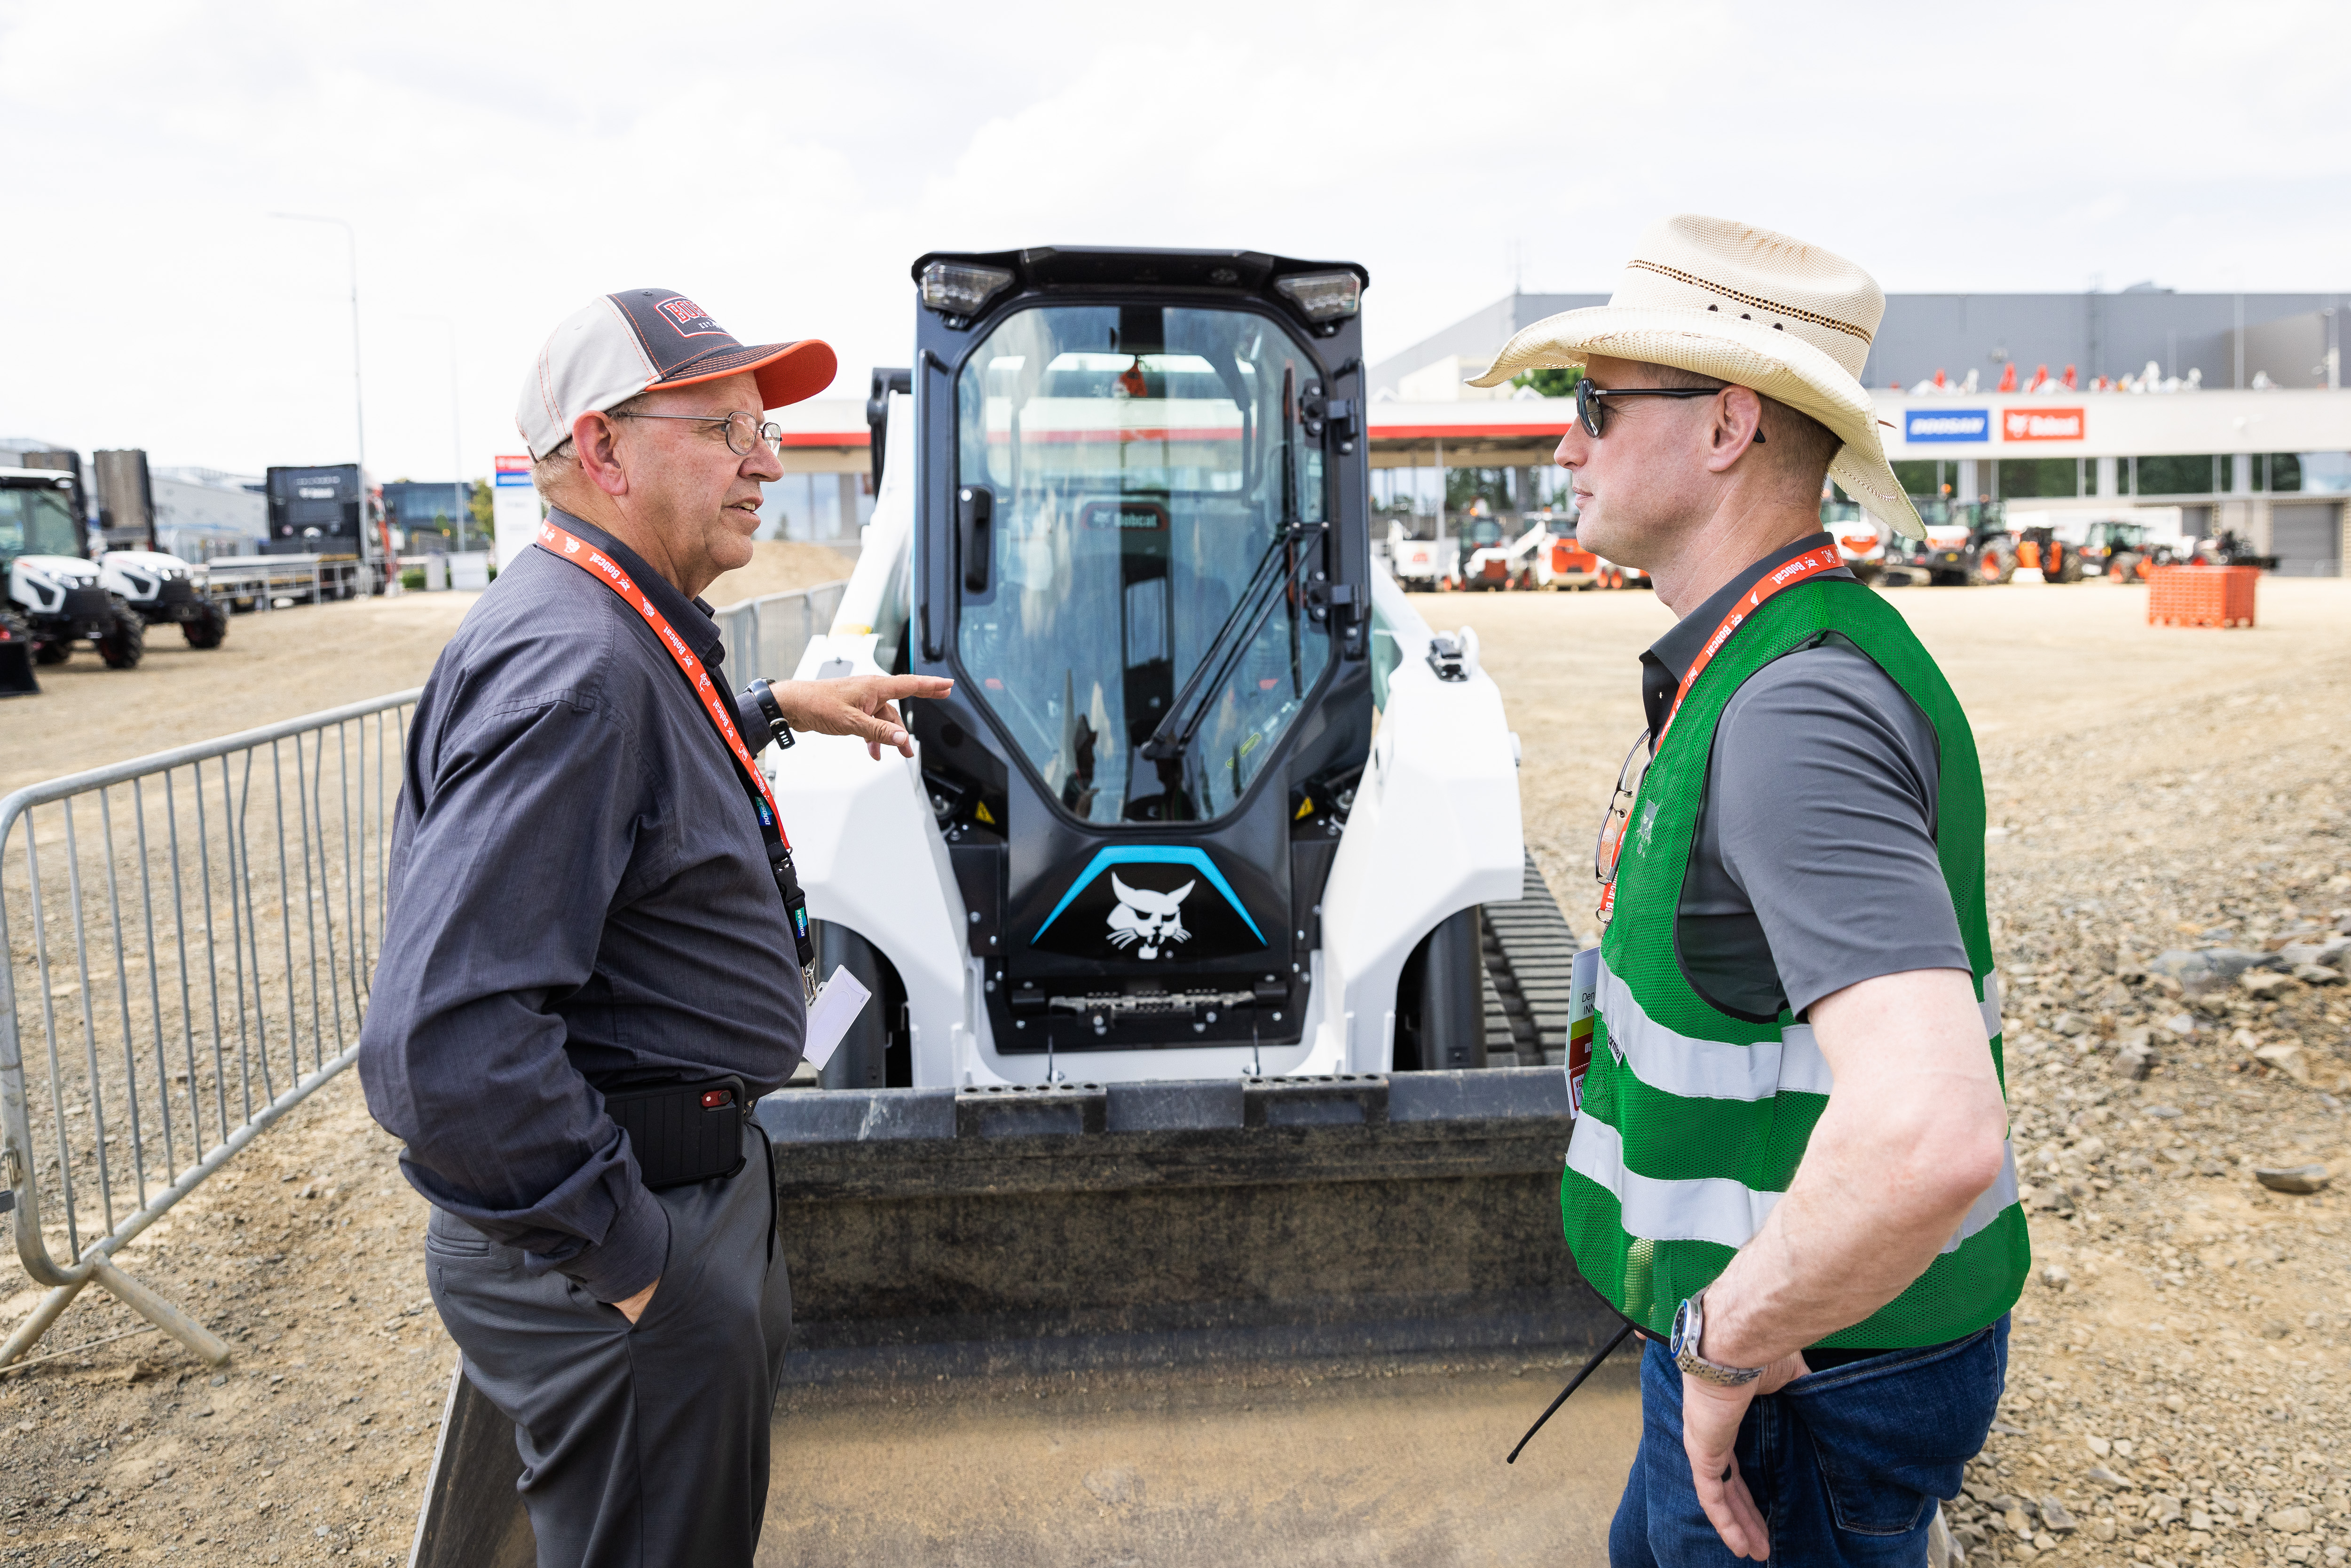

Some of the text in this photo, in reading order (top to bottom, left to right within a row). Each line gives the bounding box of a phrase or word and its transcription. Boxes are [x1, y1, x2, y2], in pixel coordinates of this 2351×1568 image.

[663, 300, 710, 324] BOB
[1114, 512, 1158, 528] Bobcat
[589, 552, 621, 579] Bobcat
[1771, 561, 1806, 584] Bobcat
[663, 625, 686, 655] Bobcat
[1705, 624, 1732, 658] Bobcat
[712, 698, 729, 728] Bobcat
[754, 767, 766, 794] Bobcat
[756, 796, 771, 825] DOOSAN
[797, 909, 805, 937] DOOSAN
[1582, 992, 1596, 1002] Den
